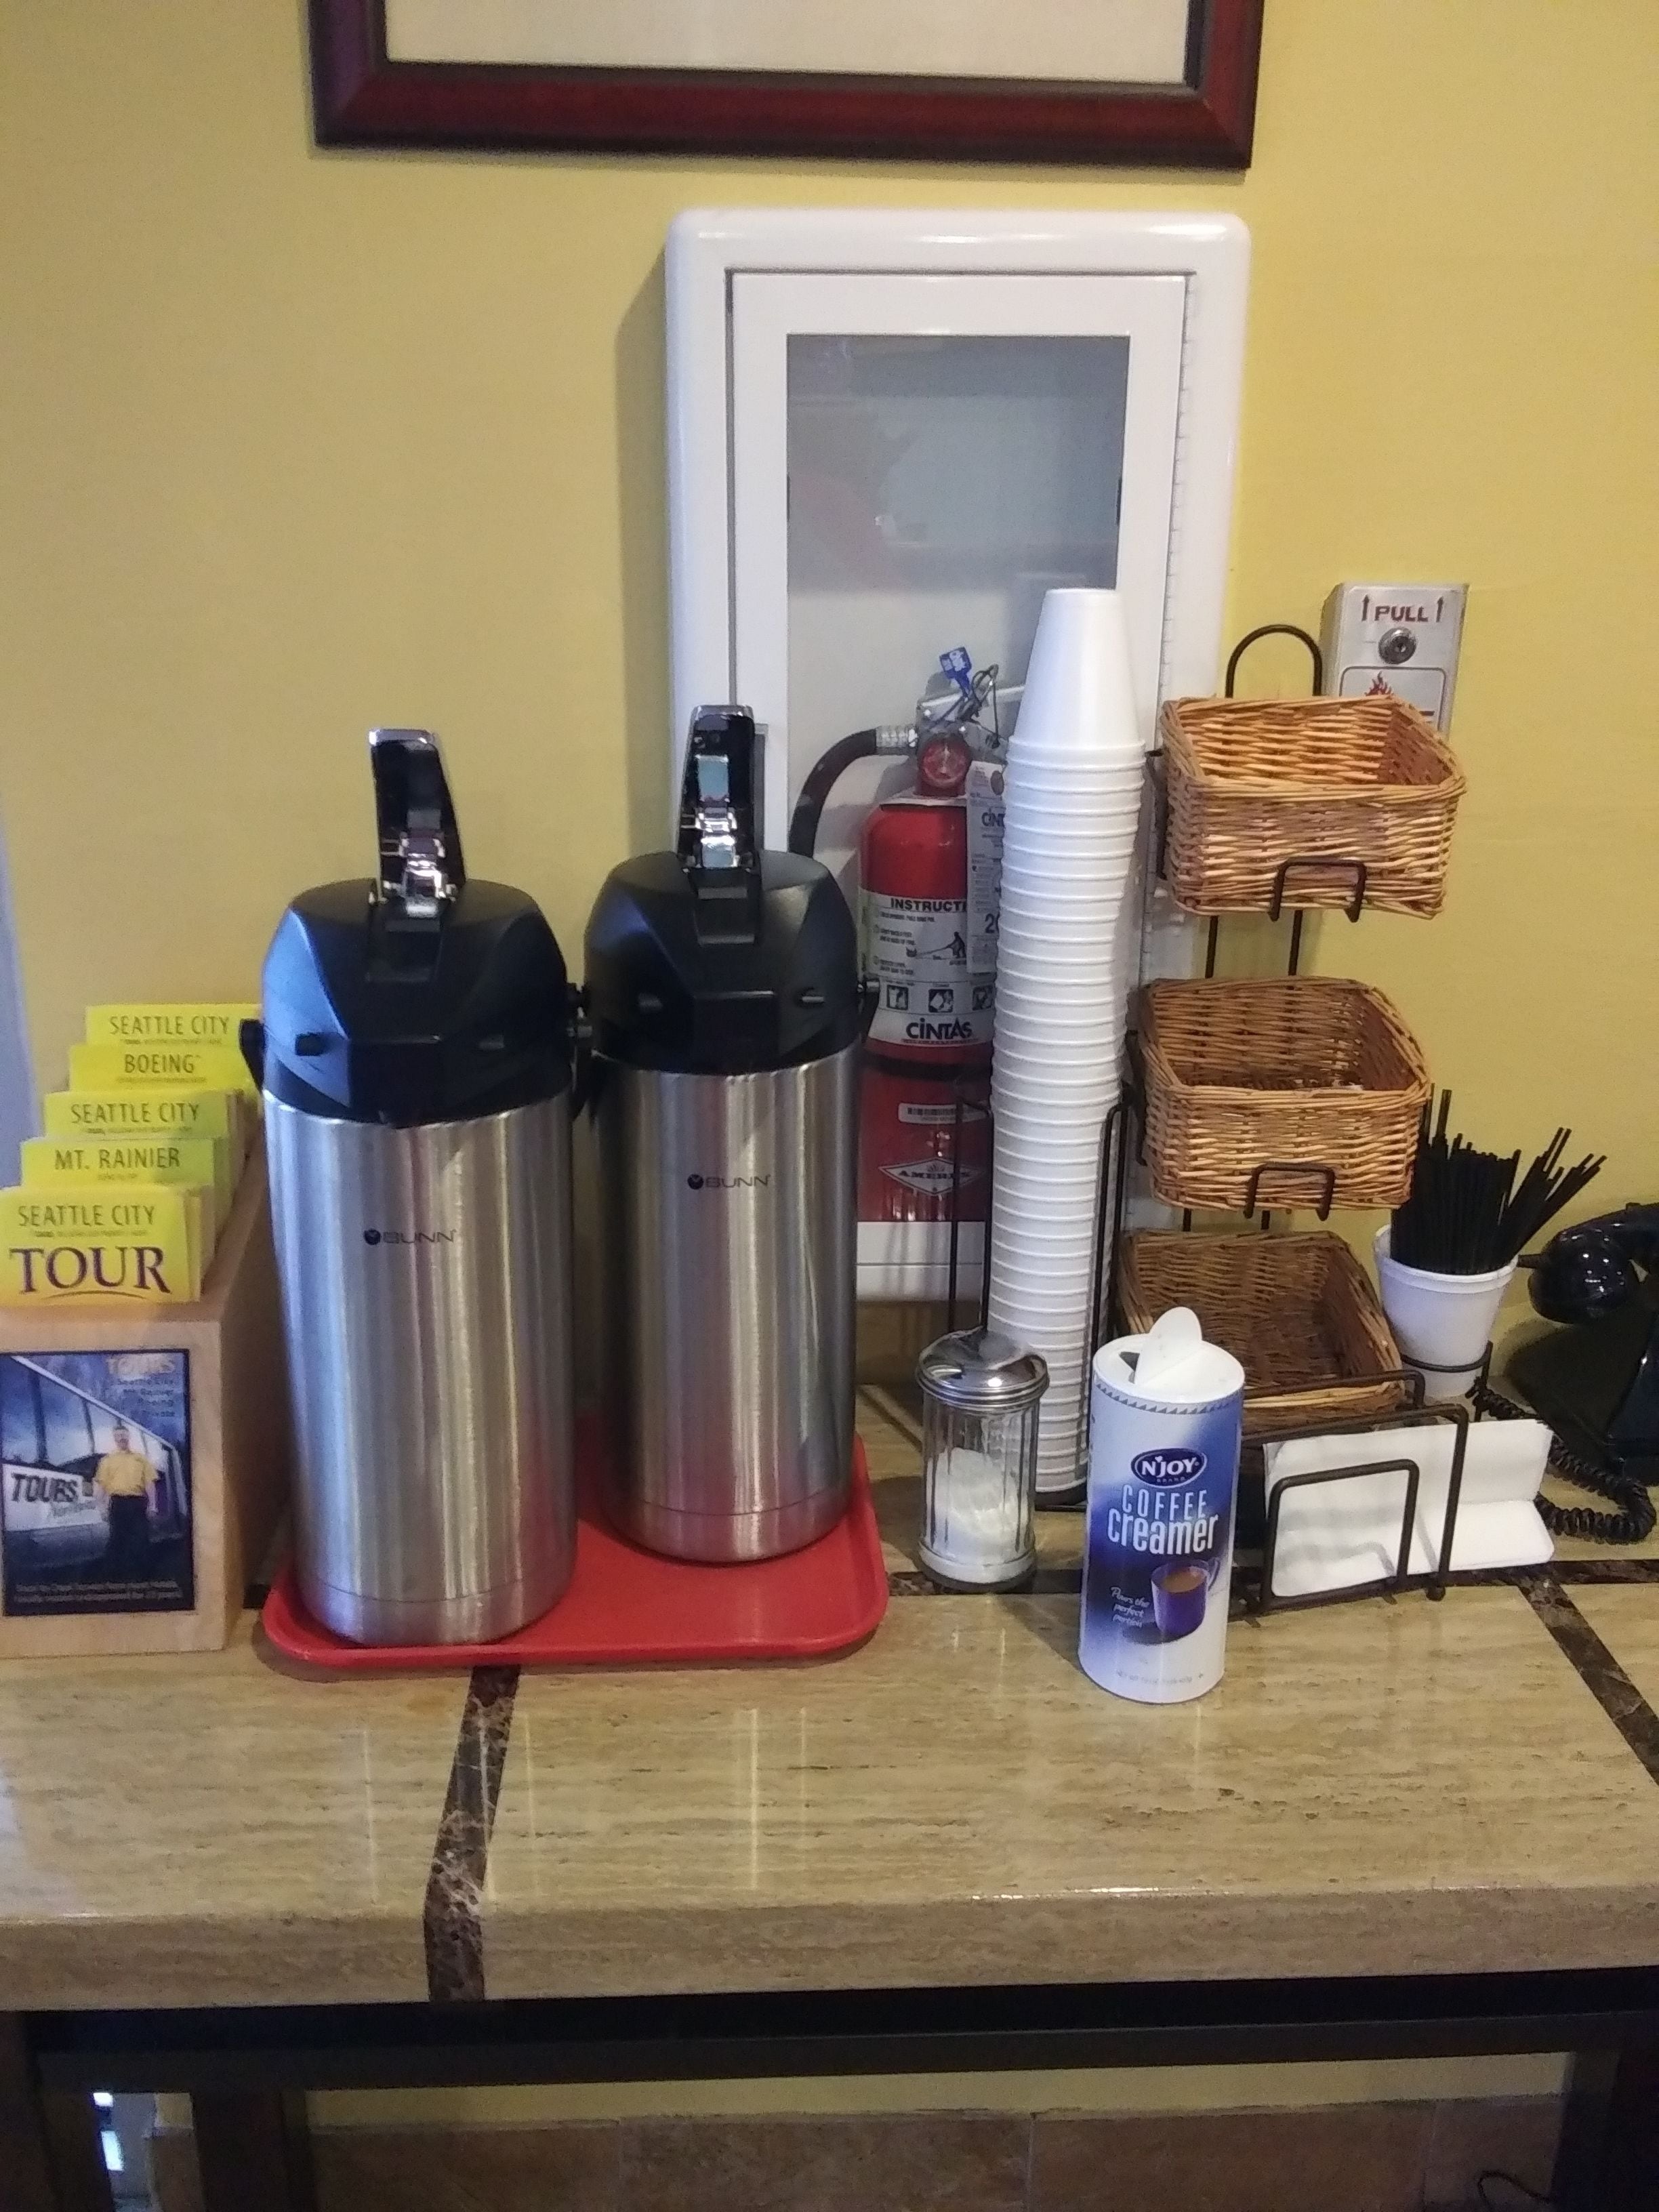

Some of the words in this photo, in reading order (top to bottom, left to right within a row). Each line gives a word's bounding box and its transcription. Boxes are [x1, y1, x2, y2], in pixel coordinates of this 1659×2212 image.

[1374, 605, 1429, 623] PULL
[109, 1015, 184, 1036] SEATTLE
[191, 1015, 229, 1035] CITY
[906, 1017, 973, 1040] CINTAS
[124, 1053, 194, 1074] BOEING
[70, 1103, 152, 1124] SEATTLE
[159, 1102, 199, 1123] CITY
[54, 1149, 90, 1170] MT.
[98, 1147, 181, 1169] RAINIER
[705, 1174, 770, 1188] BUNN
[18, 1204, 104, 1227] SEATTLE
[110, 1204, 155, 1226] CITY
[383, 1229, 456, 1244] BUNN
[9, 1245, 171, 1294] TOUR
[1122, 1483, 1208, 1521] COFFEE
[1107, 1508, 1219, 1555] creamer
[1113, 1603, 1145, 1618] perfect
